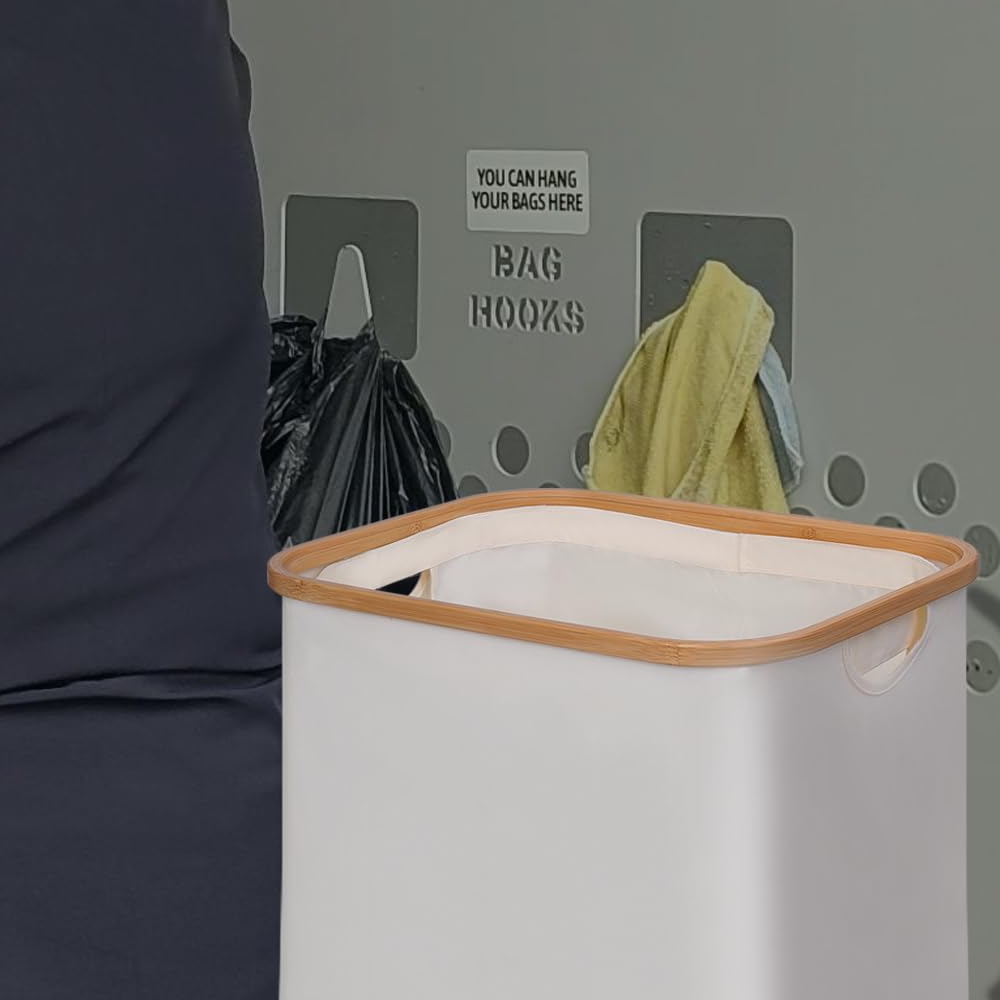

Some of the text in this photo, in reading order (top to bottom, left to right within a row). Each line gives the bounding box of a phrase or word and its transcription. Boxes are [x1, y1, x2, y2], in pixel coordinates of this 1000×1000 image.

[477, 168, 577, 188] YOU CAN HANG
[472, 191, 583, 212] YOUR BAGS HERE
[491, 244, 562, 281] BAG
[469, 294, 585, 334] HOOKS
